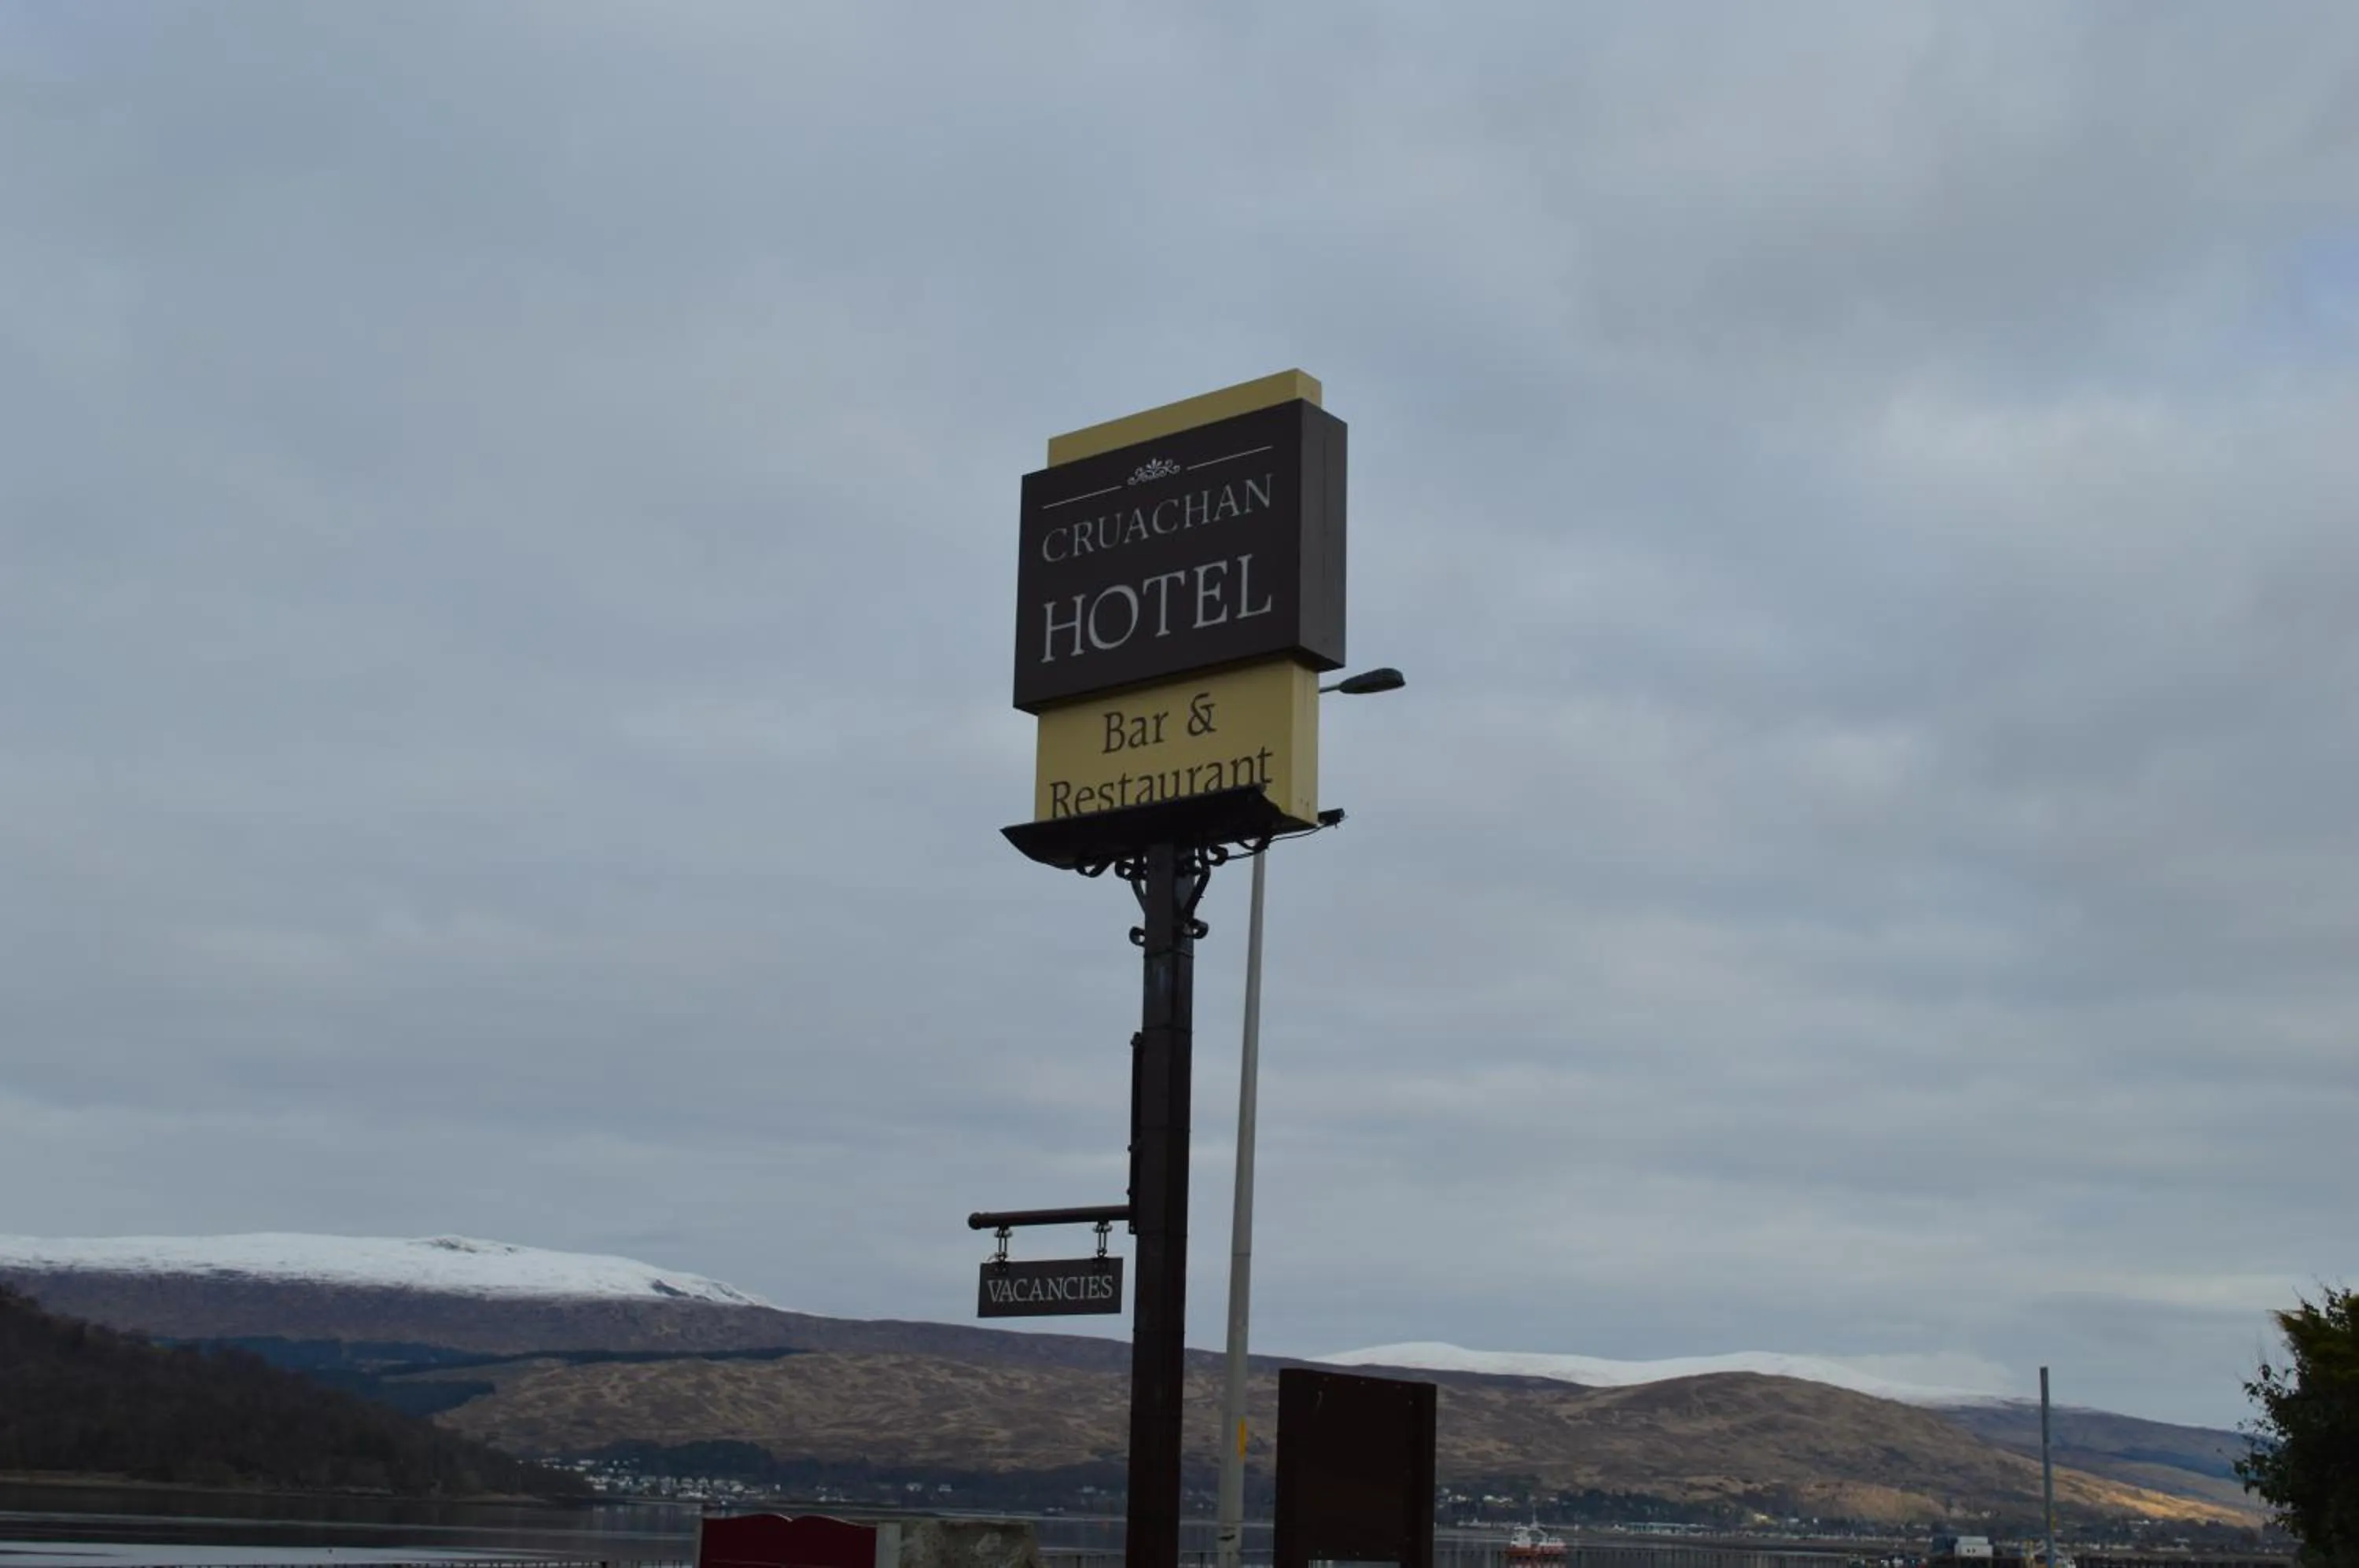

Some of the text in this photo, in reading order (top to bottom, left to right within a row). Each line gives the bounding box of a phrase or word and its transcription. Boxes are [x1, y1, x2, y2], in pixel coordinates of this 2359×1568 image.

[1042, 473, 1274, 562] CRUACHAN
[1041, 554, 1272, 663] HOTEL
[1102, 693, 1217, 754] Bar &
[1050, 745, 1273, 819] Restaurant
[988, 1275, 1113, 1303] VACANCIES
